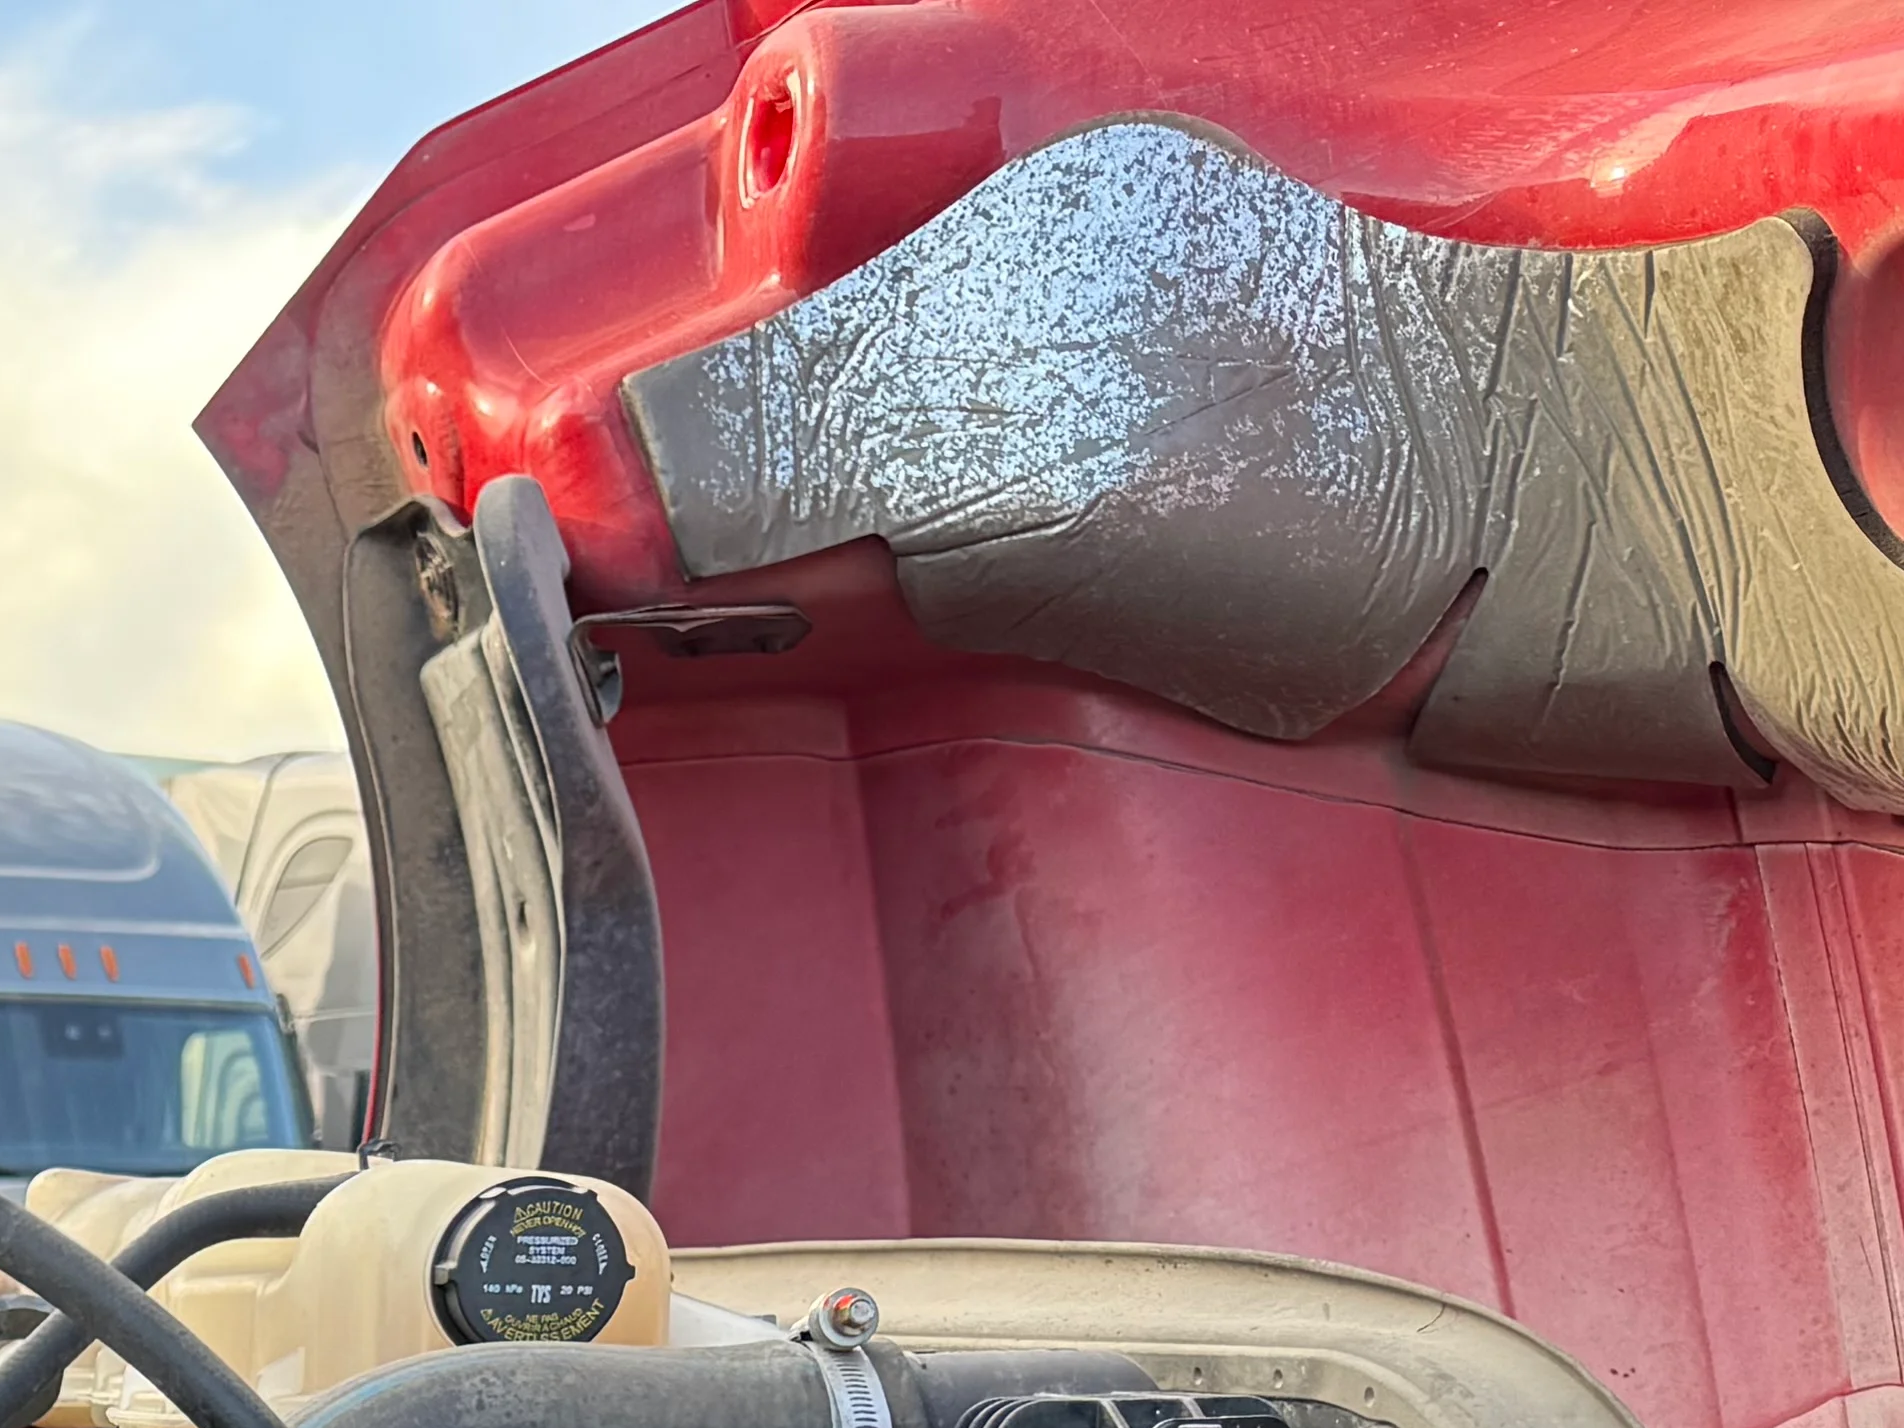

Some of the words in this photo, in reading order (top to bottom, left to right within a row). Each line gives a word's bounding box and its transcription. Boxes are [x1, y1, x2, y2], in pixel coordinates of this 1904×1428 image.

[526, 1200, 584, 1221] CAUTION
[510, 1217, 541, 1237] NEVER
[517, 1236, 579, 1246] PRESSURIZED
[529, 1246, 566, 1255] SYSTEM
